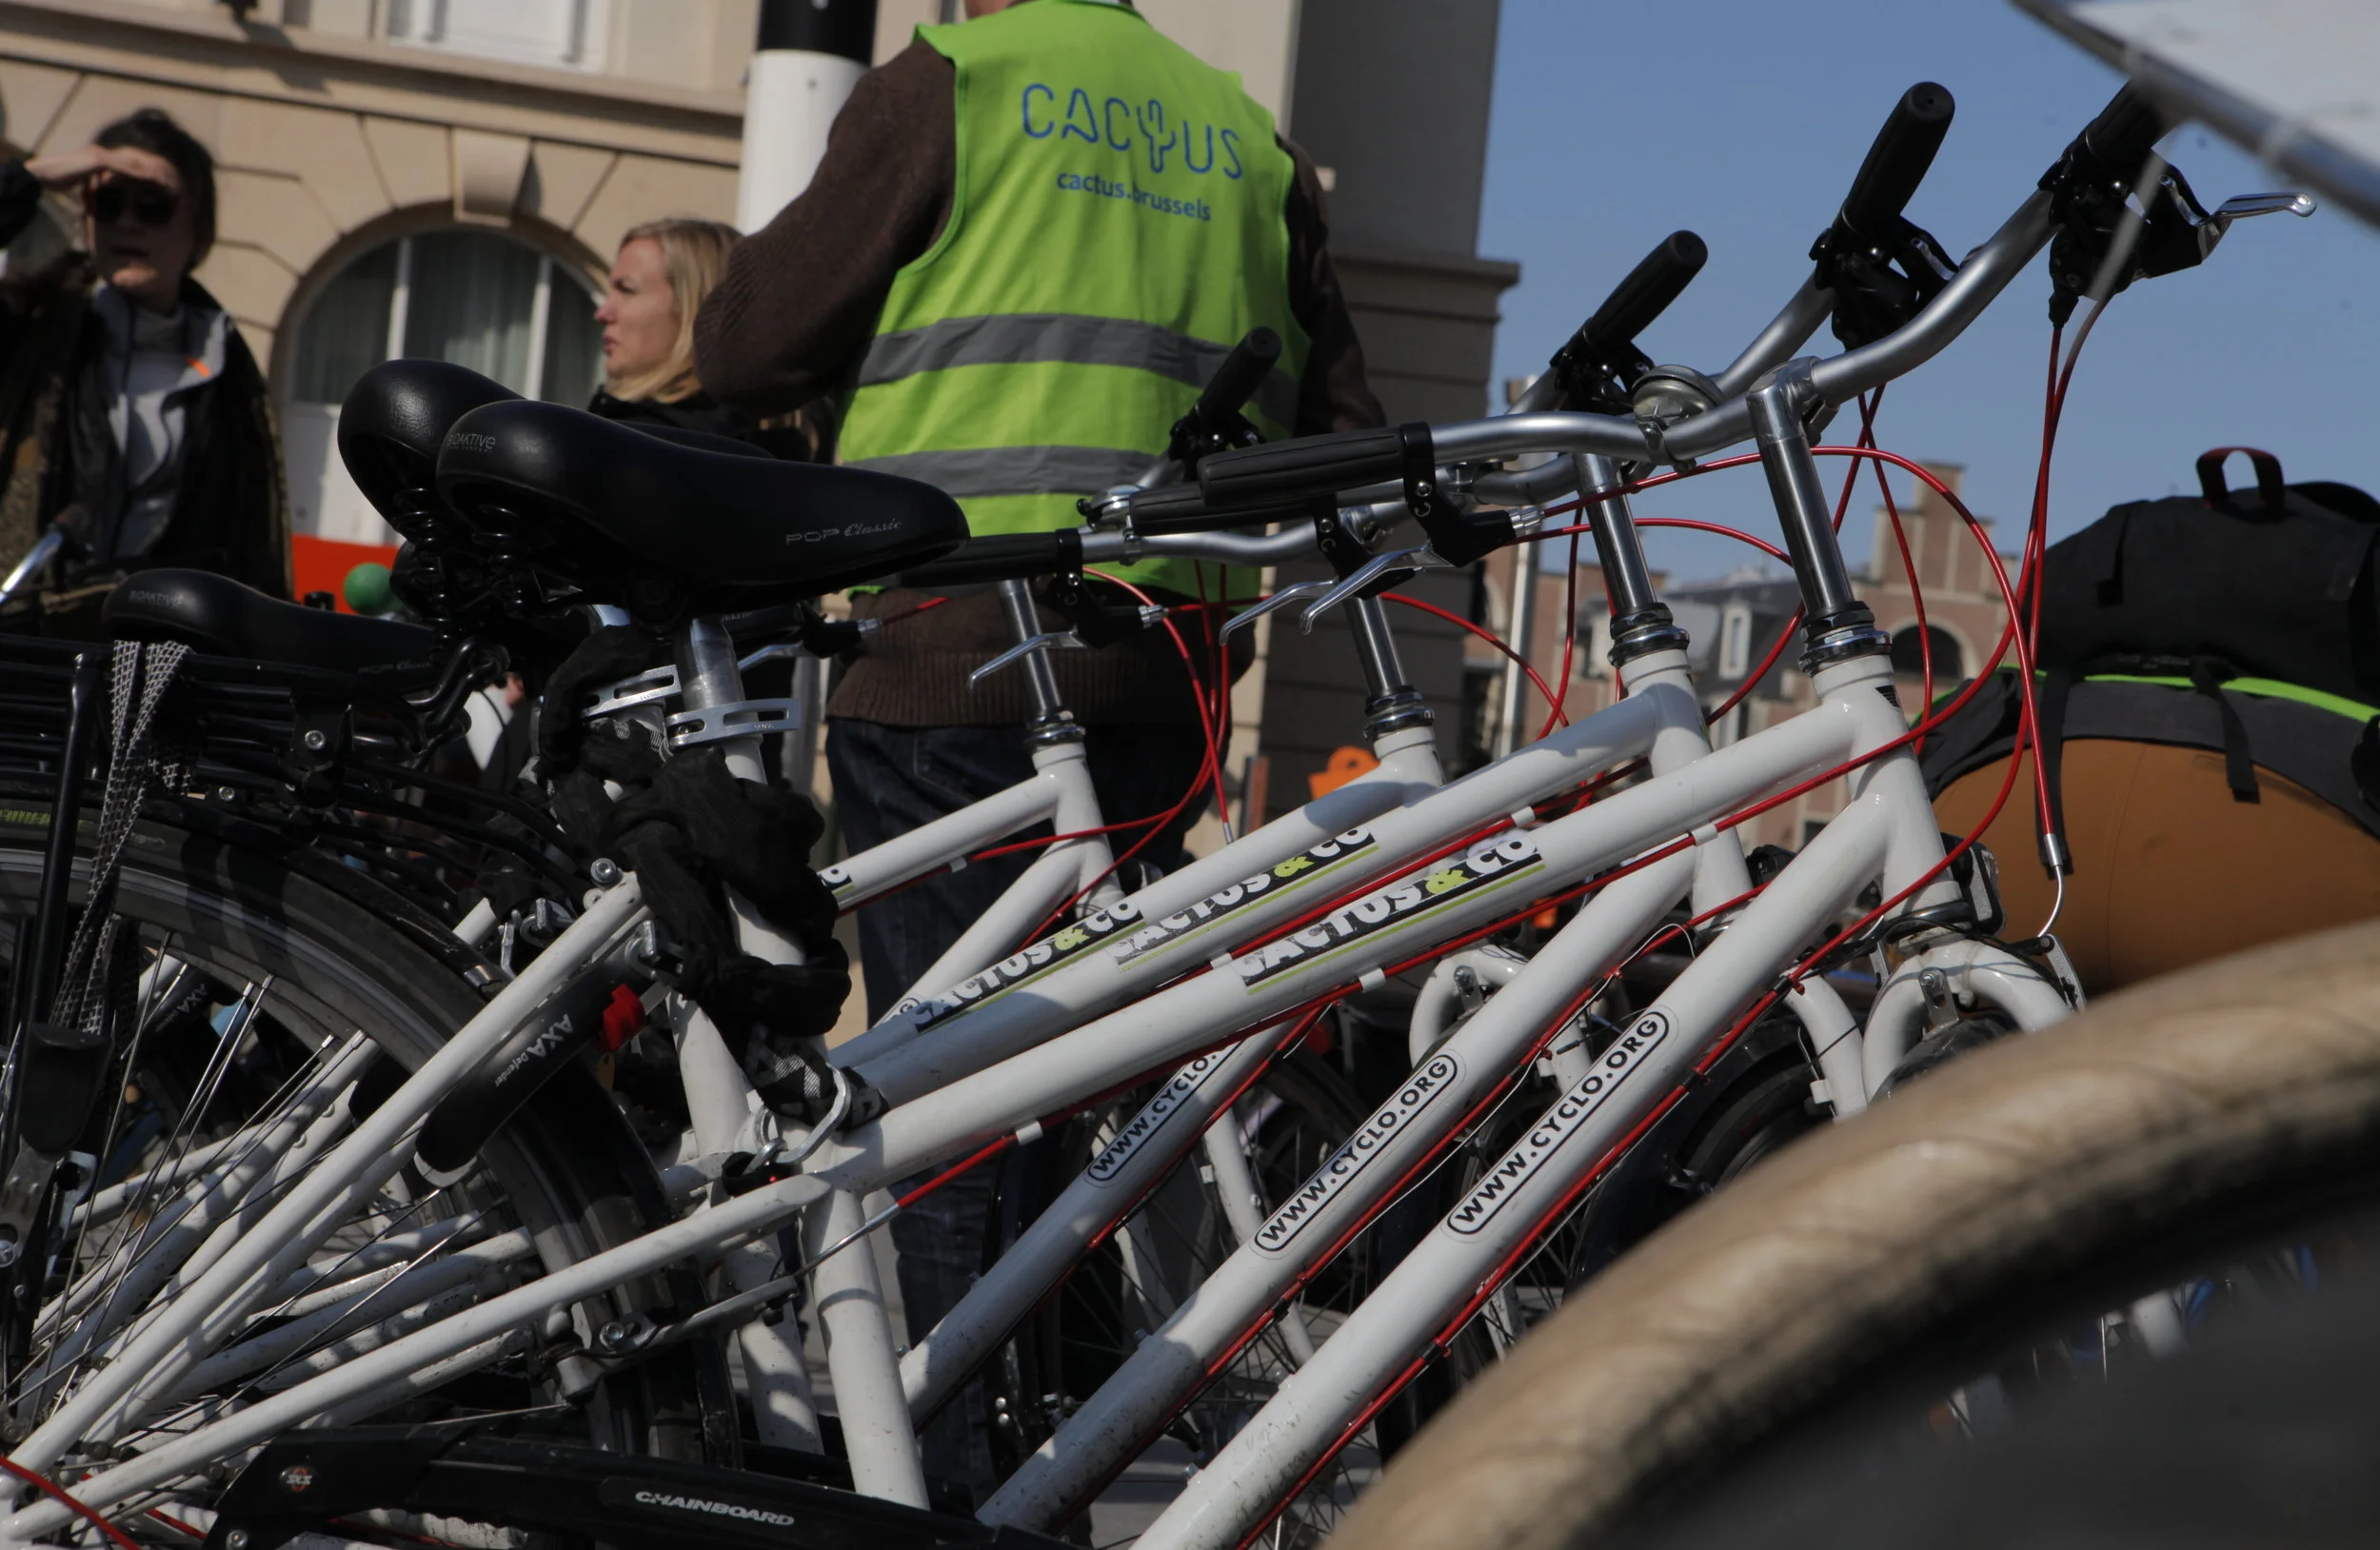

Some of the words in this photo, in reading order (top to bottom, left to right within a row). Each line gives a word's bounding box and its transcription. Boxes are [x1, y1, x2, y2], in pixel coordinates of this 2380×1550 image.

[1056, 171, 1212, 222] cactus.brussels
[784, 528, 840, 546] POP
[526, 1013, 574, 1059] AXA
[494, 1051, 530, 1088] Defender
[1093, 1055, 1218, 1172] WWW.CYCLO.
[1455, 1019, 1658, 1223] WWW.CYCLO.ORG
[1261, 1061, 1448, 1242] WWW.CYCLO.ORG
[634, 1491, 796, 1526] CHAINBOARD
